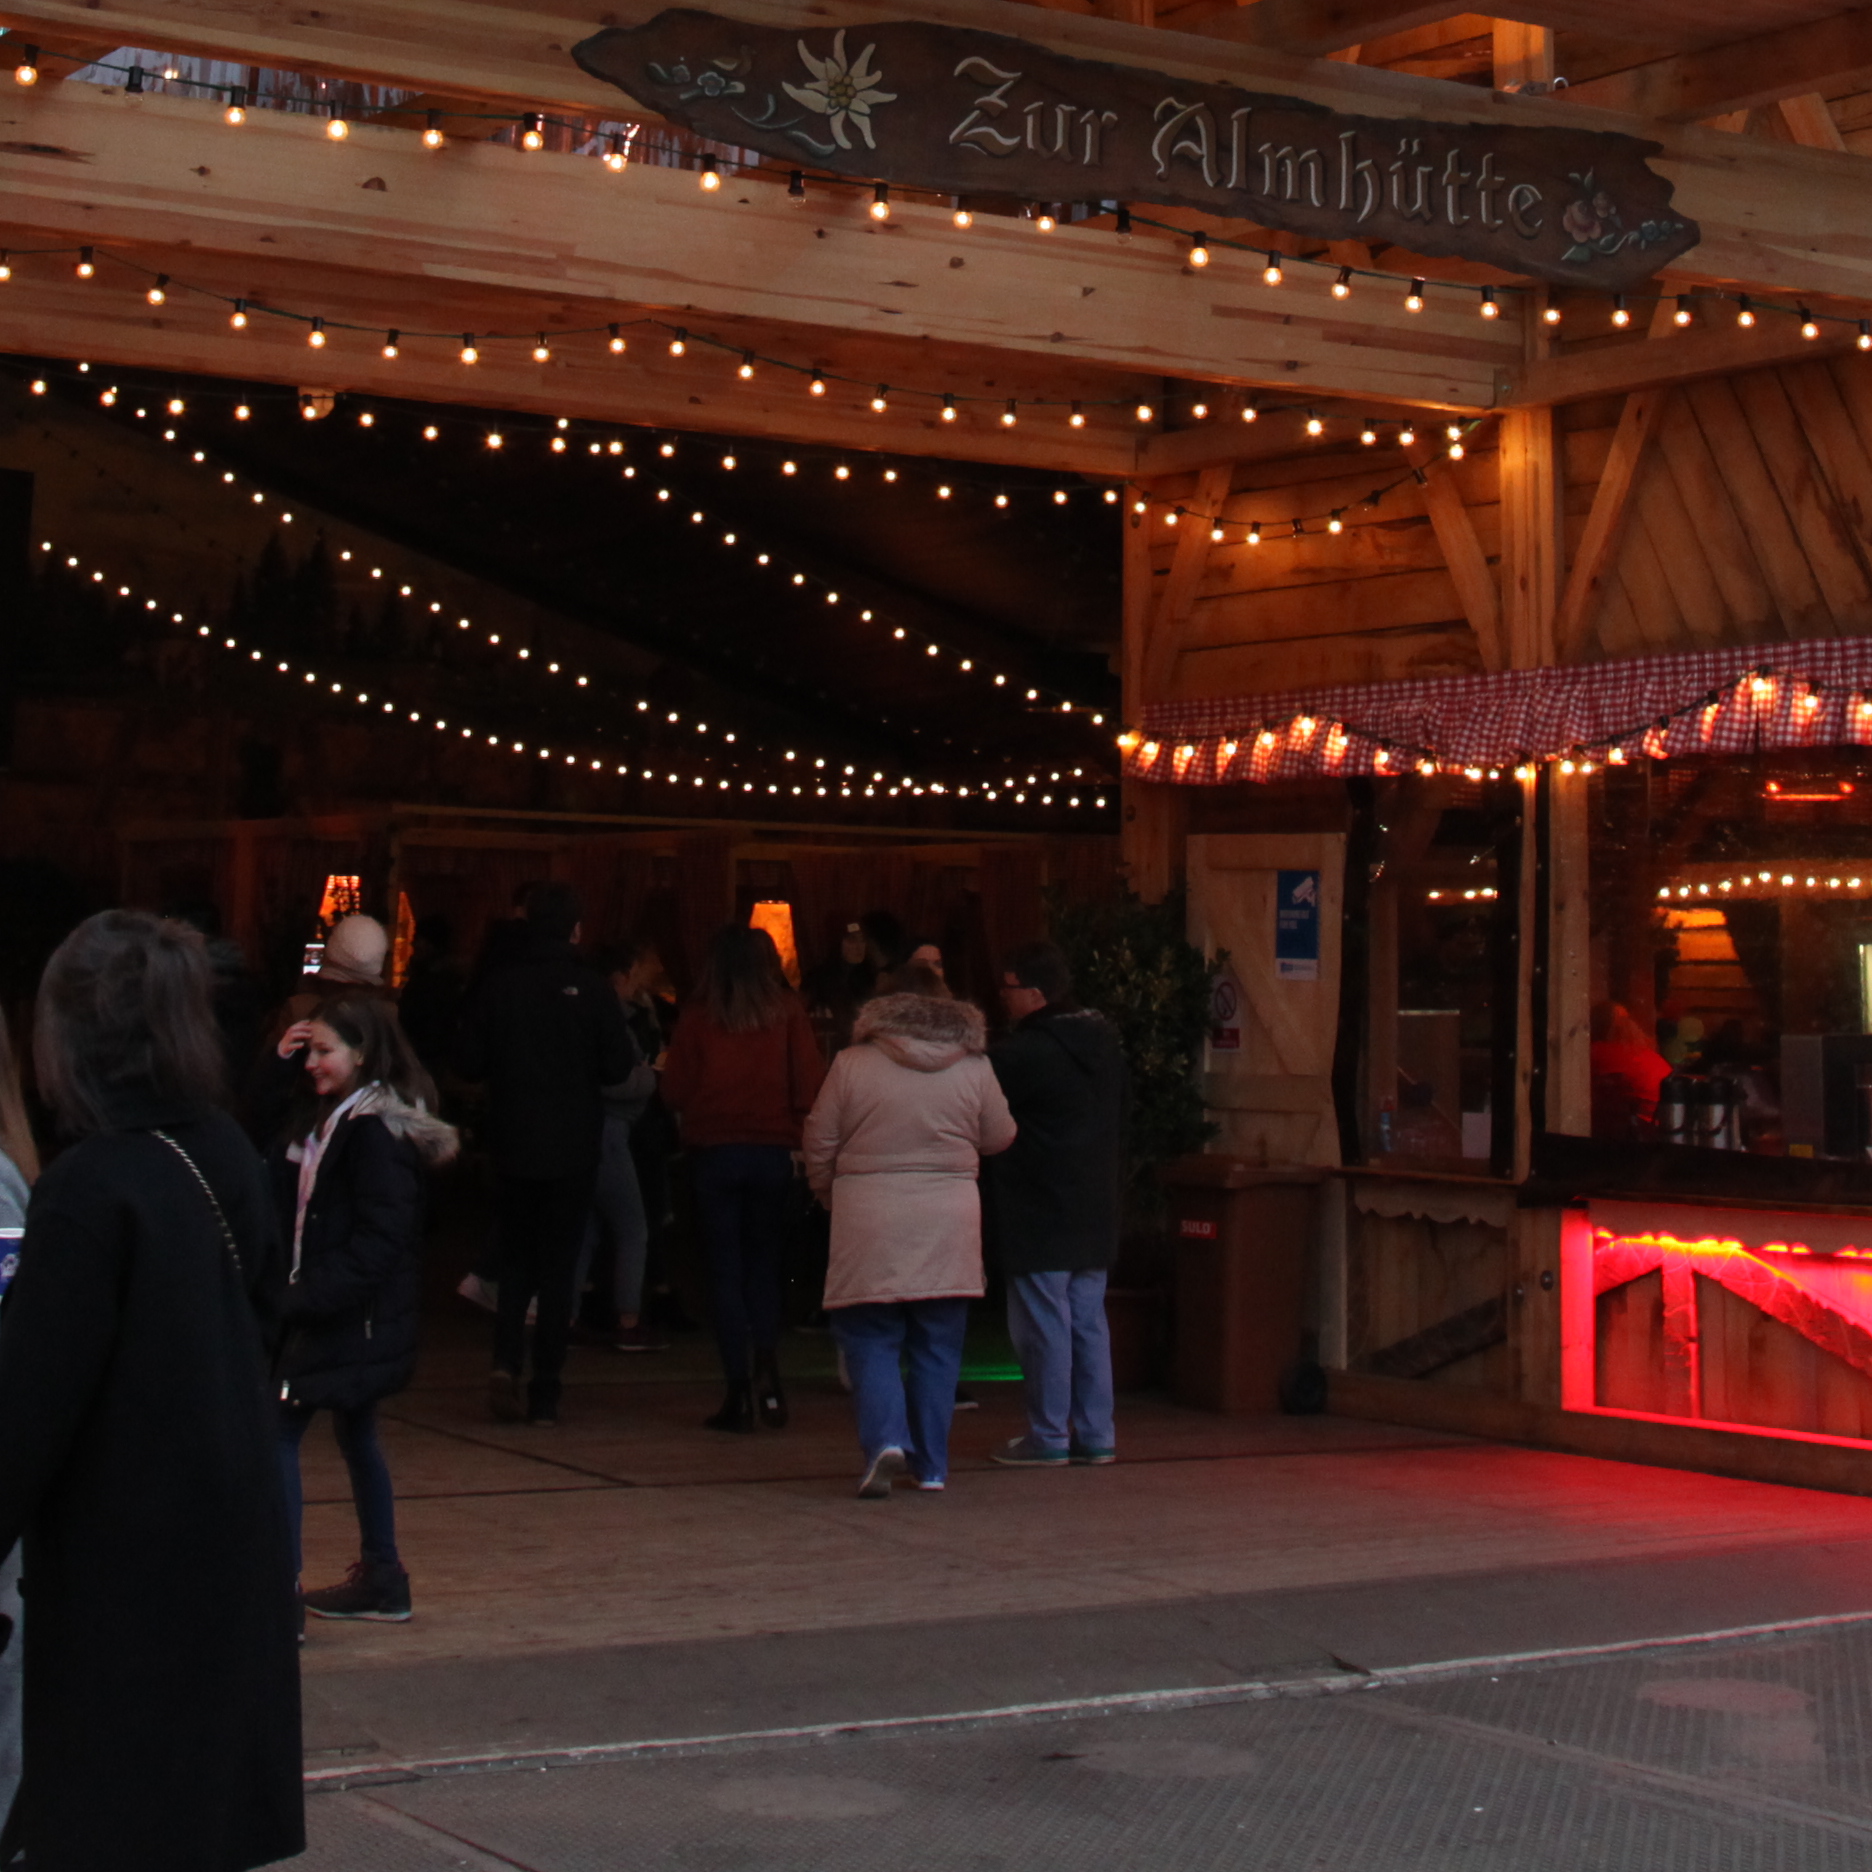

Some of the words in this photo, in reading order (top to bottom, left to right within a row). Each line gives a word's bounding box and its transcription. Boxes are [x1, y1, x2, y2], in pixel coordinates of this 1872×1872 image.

[947, 54, 1119, 168] Zur
[1151, 99, 1546, 240] Almhütte
[1181, 1220, 1211, 1235] SULO
